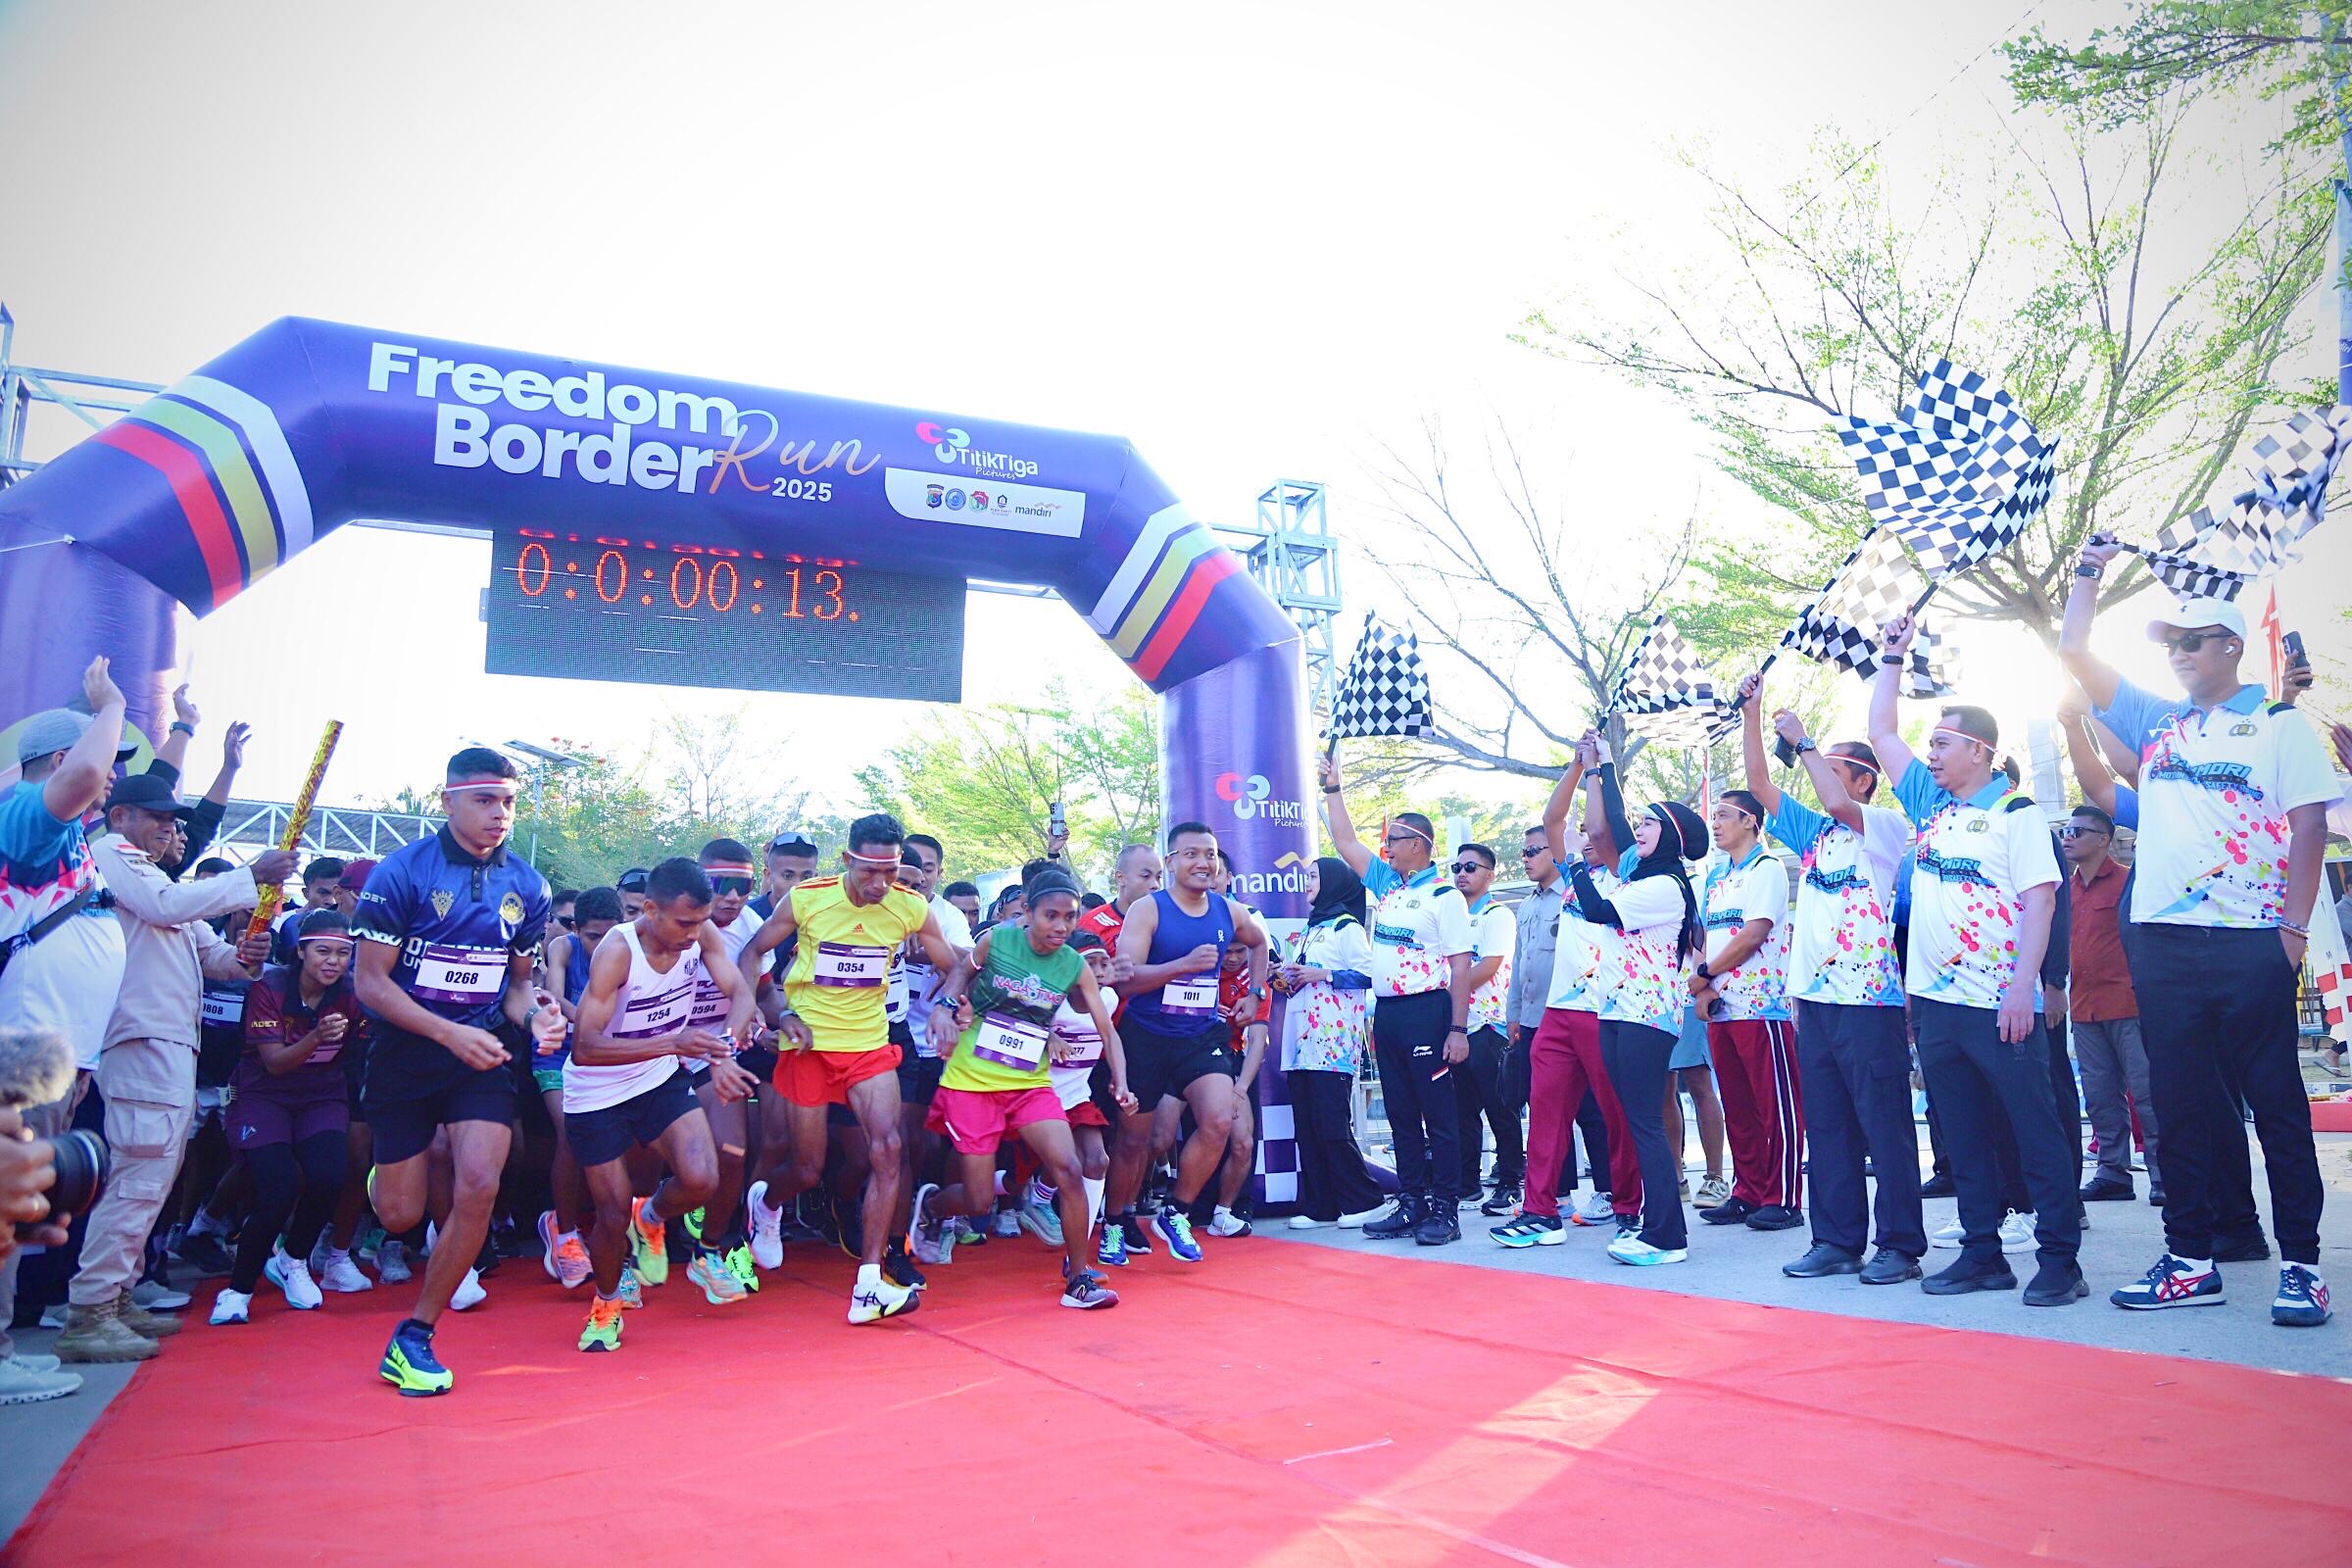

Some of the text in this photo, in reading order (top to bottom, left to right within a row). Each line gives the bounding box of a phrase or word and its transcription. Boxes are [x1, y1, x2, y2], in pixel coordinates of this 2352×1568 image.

[368, 341, 738, 437] Freedom
[434, 402, 881, 494] Border Run
[956, 448, 1039, 478] TitikTiga
[975, 466, 1016, 480] Pictures
[771, 476, 833, 503] 2025
[1255, 800, 1309, 820] TitikTi
[837, 961, 864, 973] 0354
[445, 970, 479, 985] 0268
[1183, 991, 1200, 1002] 1011
[647, 1007, 670, 1022] 1254
[999, 1034, 1024, 1050] 0991
